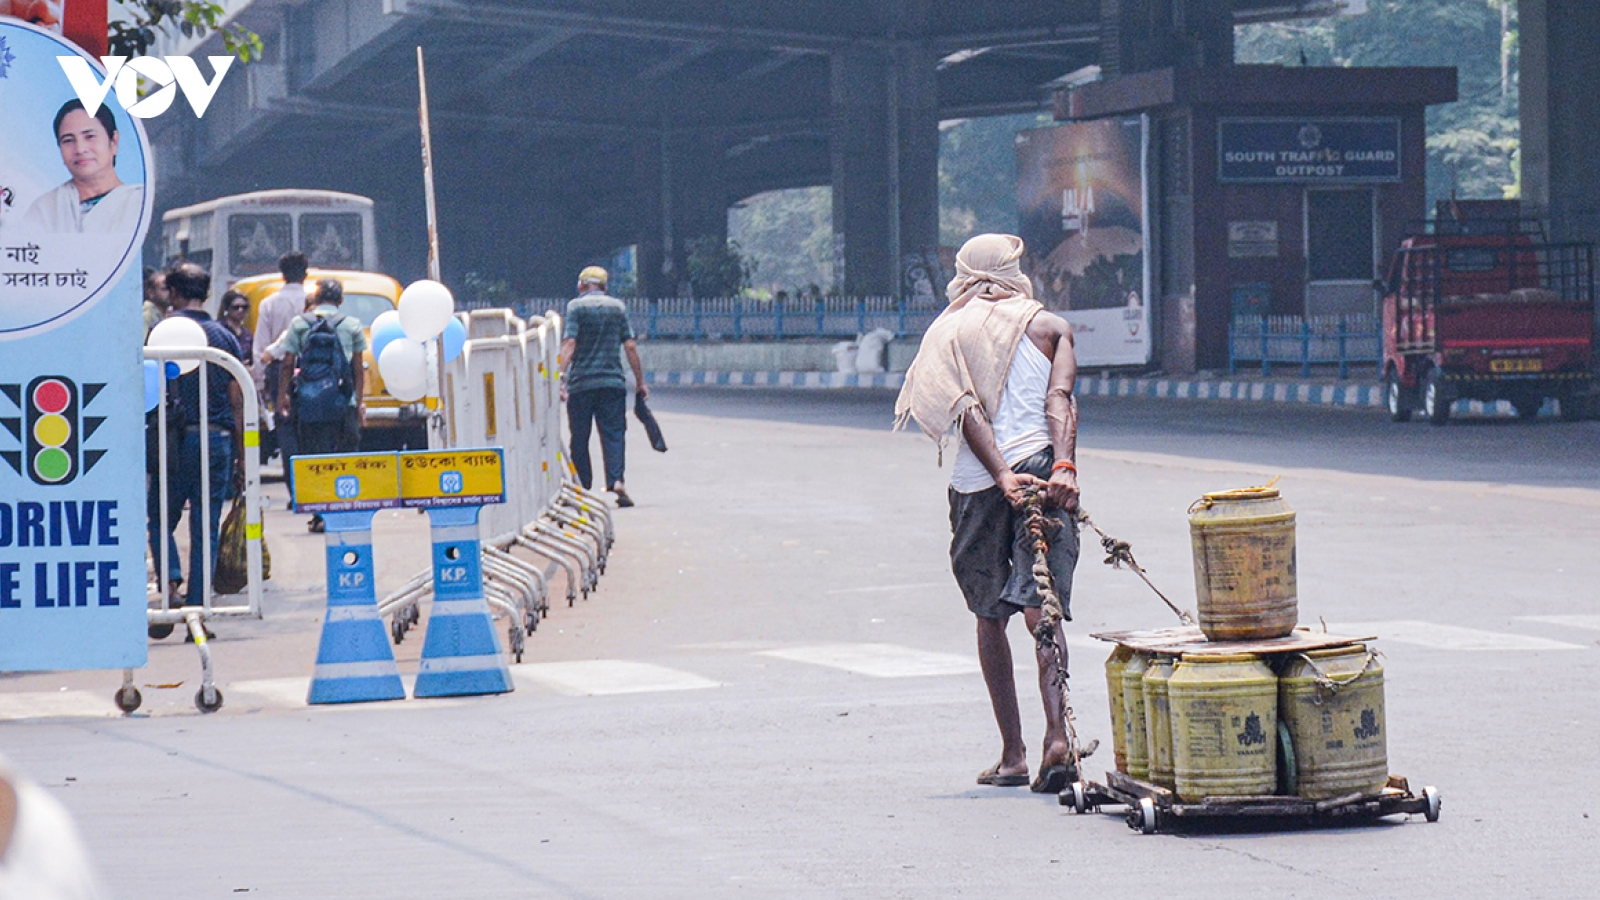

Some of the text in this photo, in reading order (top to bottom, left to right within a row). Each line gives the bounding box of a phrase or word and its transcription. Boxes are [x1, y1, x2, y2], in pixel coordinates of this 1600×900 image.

[1225, 151, 1275, 162] SOUTH
[1344, 151, 1395, 162] GUARD
[1276, 164, 1344, 176] OUTPOST
[5, 242, 40, 265] নাই
[2, 268, 88, 289] সবার চাই
[35, 561, 119, 607] LIFE
